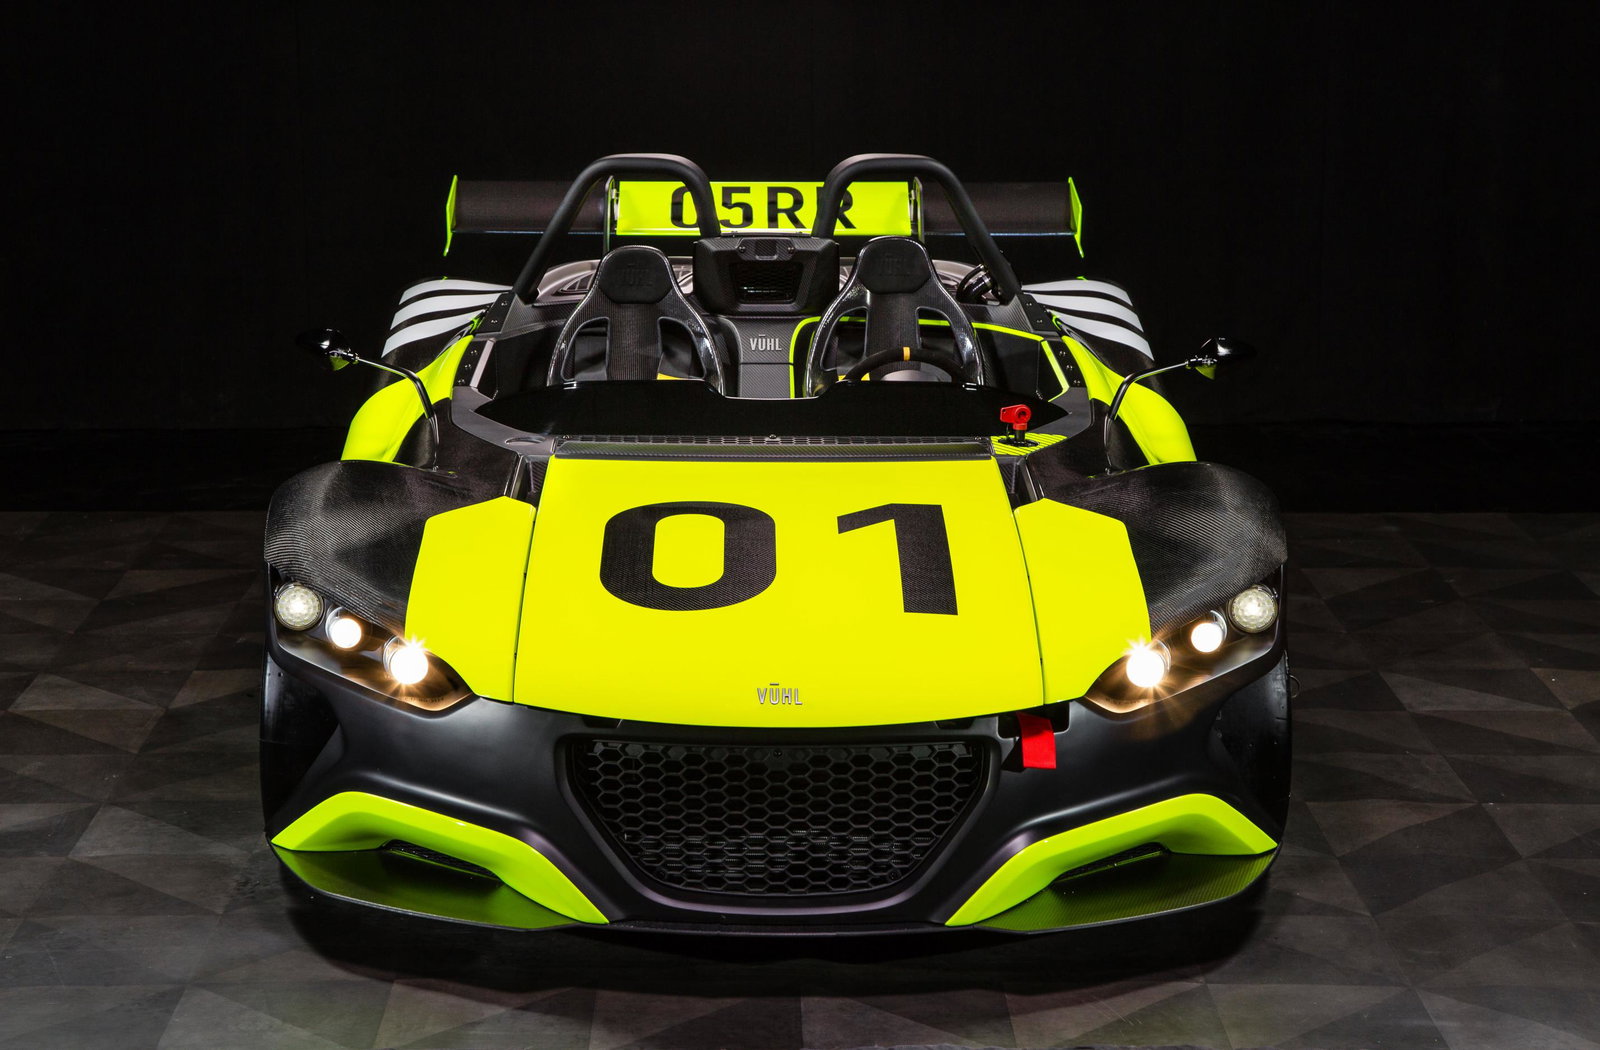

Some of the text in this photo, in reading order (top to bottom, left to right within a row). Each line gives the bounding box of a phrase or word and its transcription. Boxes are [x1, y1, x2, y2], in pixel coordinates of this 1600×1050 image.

[750, 334, 782, 351] VŪHL
[599, 500, 958, 616] 01
[757, 682, 803, 705] VŪHL
